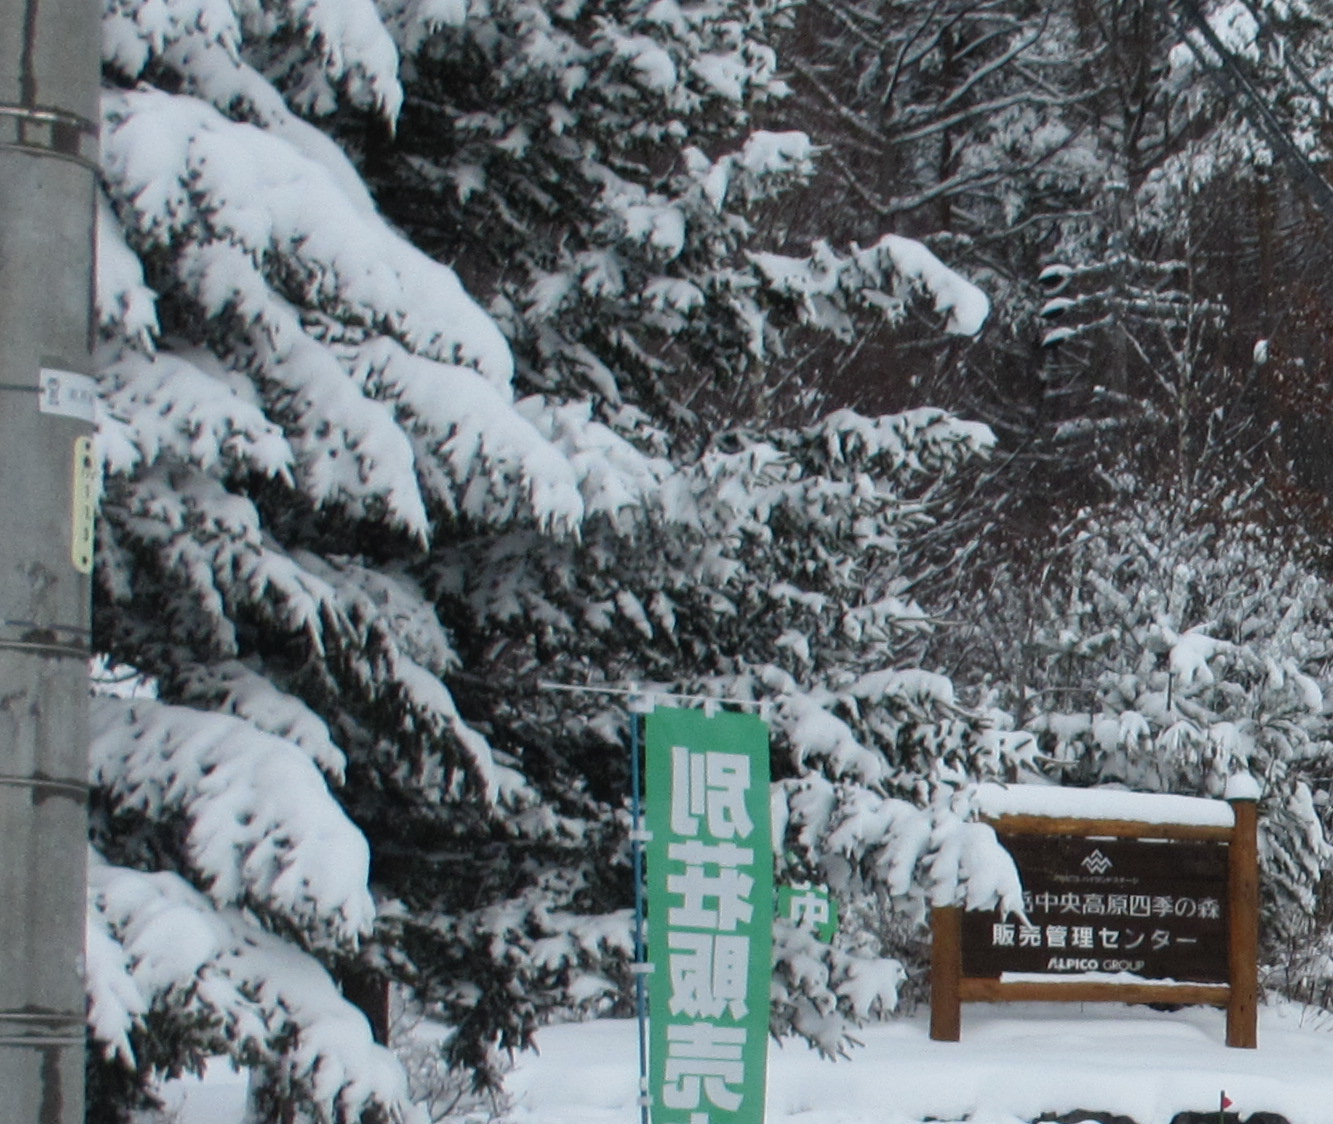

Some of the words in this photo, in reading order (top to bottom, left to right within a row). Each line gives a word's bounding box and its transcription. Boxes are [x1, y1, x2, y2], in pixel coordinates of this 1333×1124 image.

[992, 923, 1198, 950] 販売管理センター
[1047, 957, 1099, 971] ALPICO
[1103, 959, 1145, 972] GROUP
